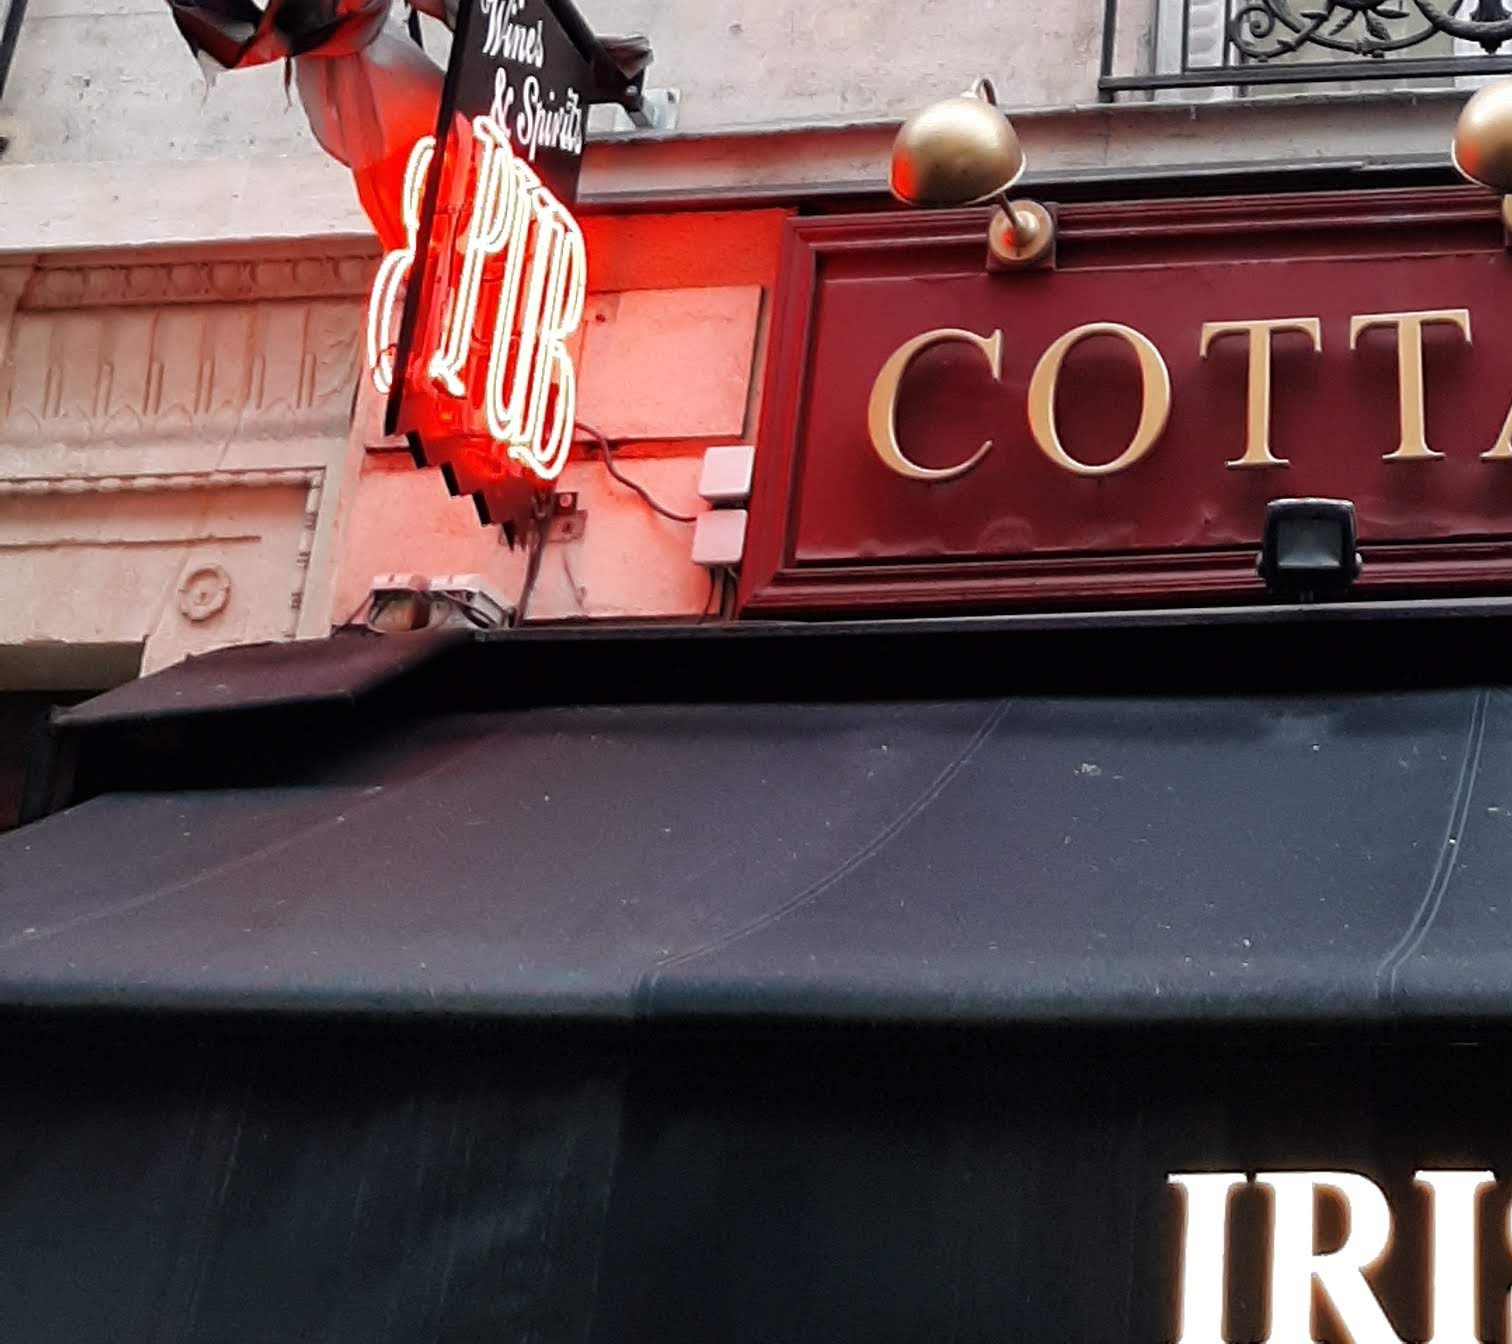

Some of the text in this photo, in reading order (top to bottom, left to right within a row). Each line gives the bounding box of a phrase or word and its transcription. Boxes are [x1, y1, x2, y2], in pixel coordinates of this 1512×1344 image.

[491, 66, 584, 161] & Spirits
[428, 115, 588, 481] PUB
